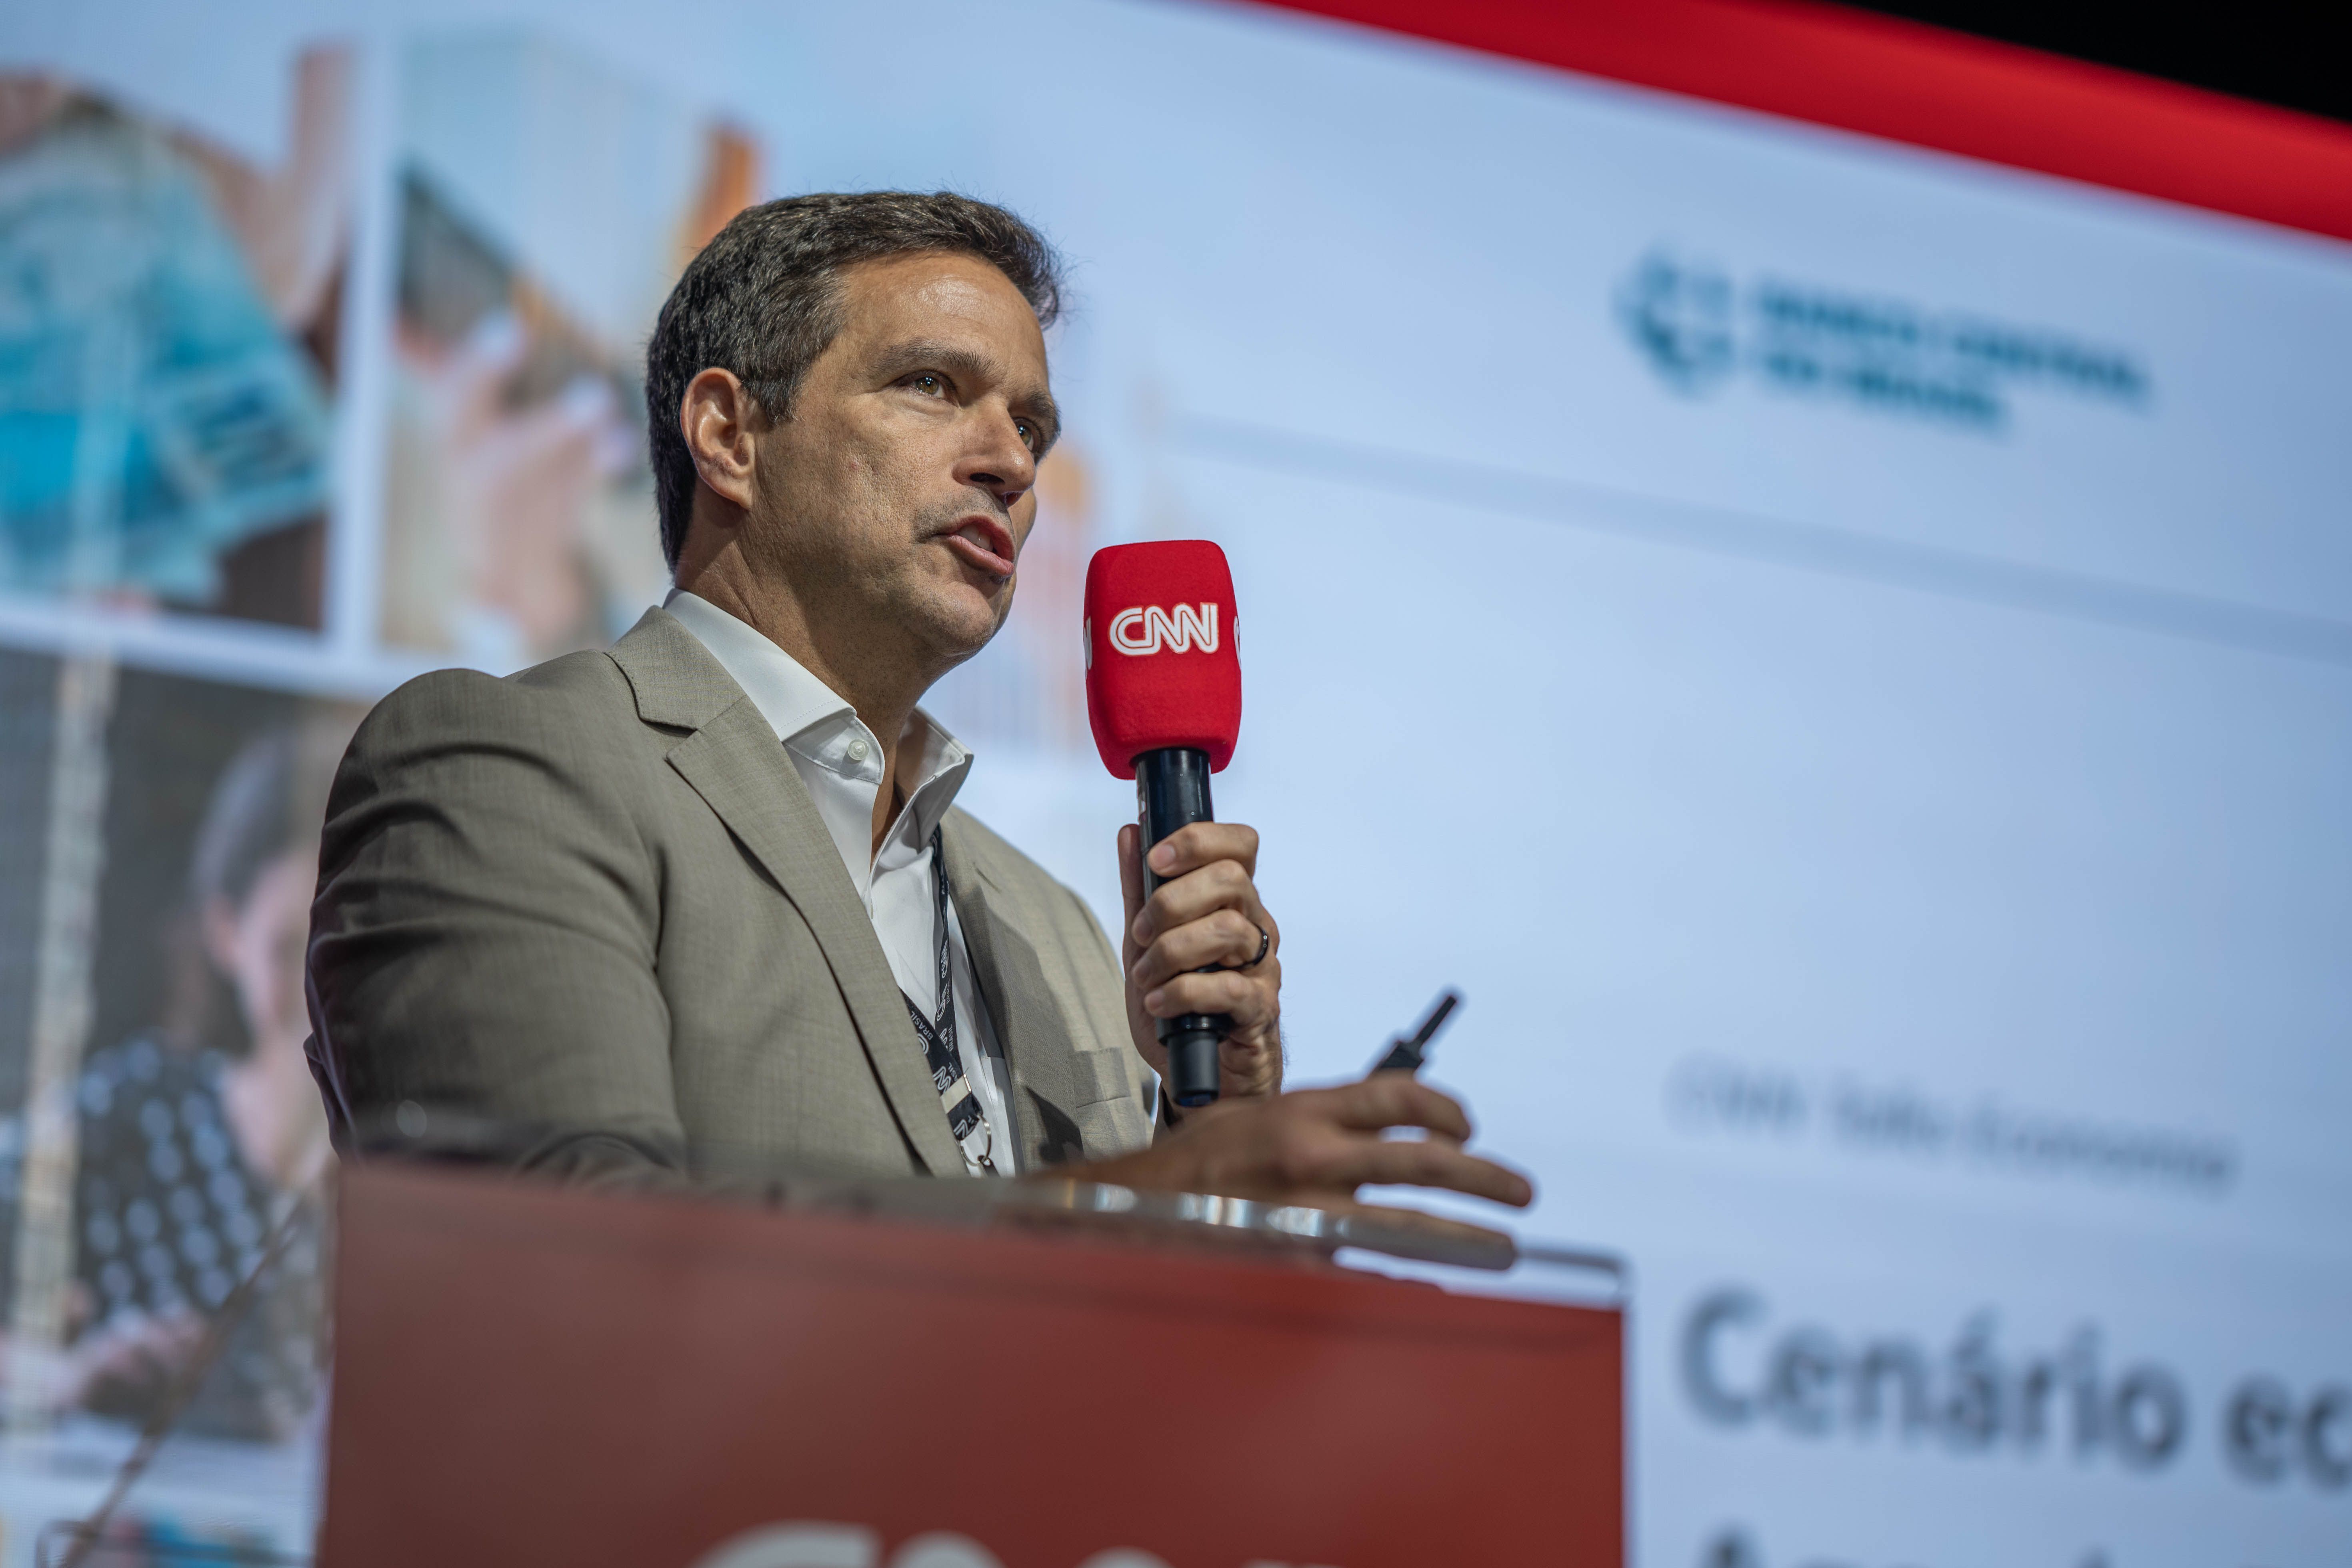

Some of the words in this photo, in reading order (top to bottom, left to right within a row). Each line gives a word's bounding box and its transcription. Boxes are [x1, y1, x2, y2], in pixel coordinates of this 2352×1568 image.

[1109, 602, 1218, 656] CNN
[911, 1011, 933, 1040] BRASIL
[1681, 1285, 2186, 1470] Cenário
